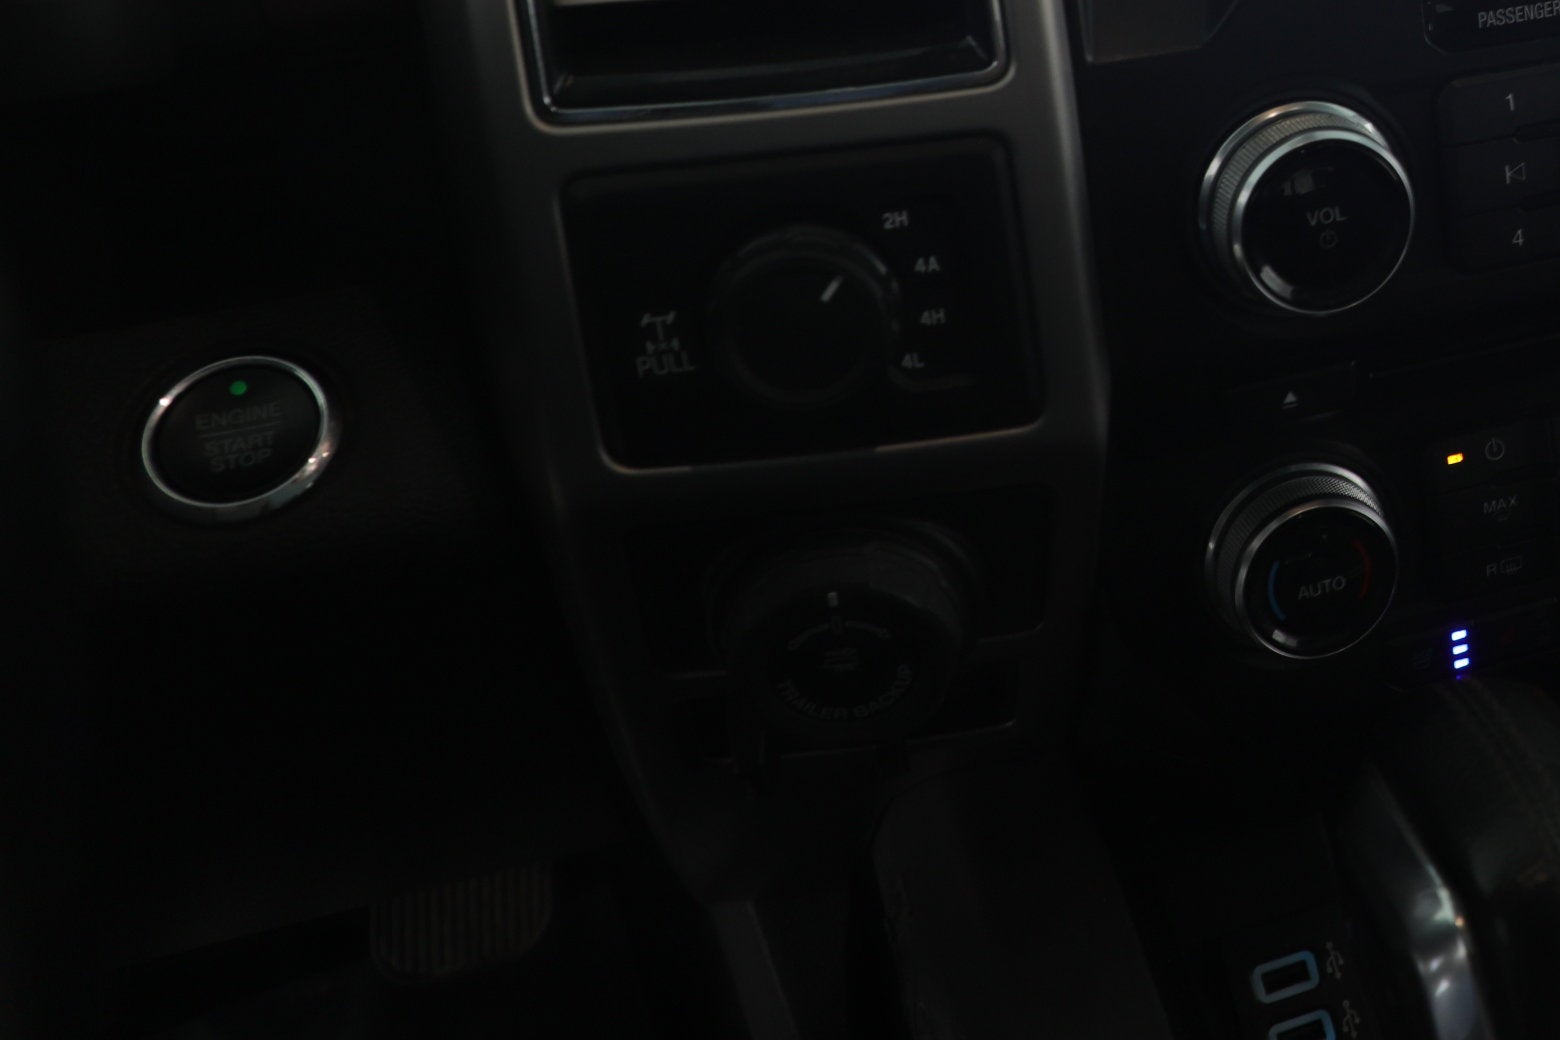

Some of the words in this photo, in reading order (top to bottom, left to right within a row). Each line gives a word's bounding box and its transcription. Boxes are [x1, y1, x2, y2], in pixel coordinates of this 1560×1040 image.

[1505, 93, 1516, 111] 1
[881, 209, 909, 230] 2H
[1306, 205, 1349, 227] VOL
[1511, 228, 1525, 247] 4
[914, 255, 941, 274] 4A
[920, 308, 945, 326] 4H
[636, 351, 695, 378] PULL
[194, 402, 282, 429] ENGINE
[203, 430, 274, 458] START
[209, 447, 272, 473] STOP
[1482, 493, 1518, 515] MAX
[1297, 574, 1347, 600] AUTO
